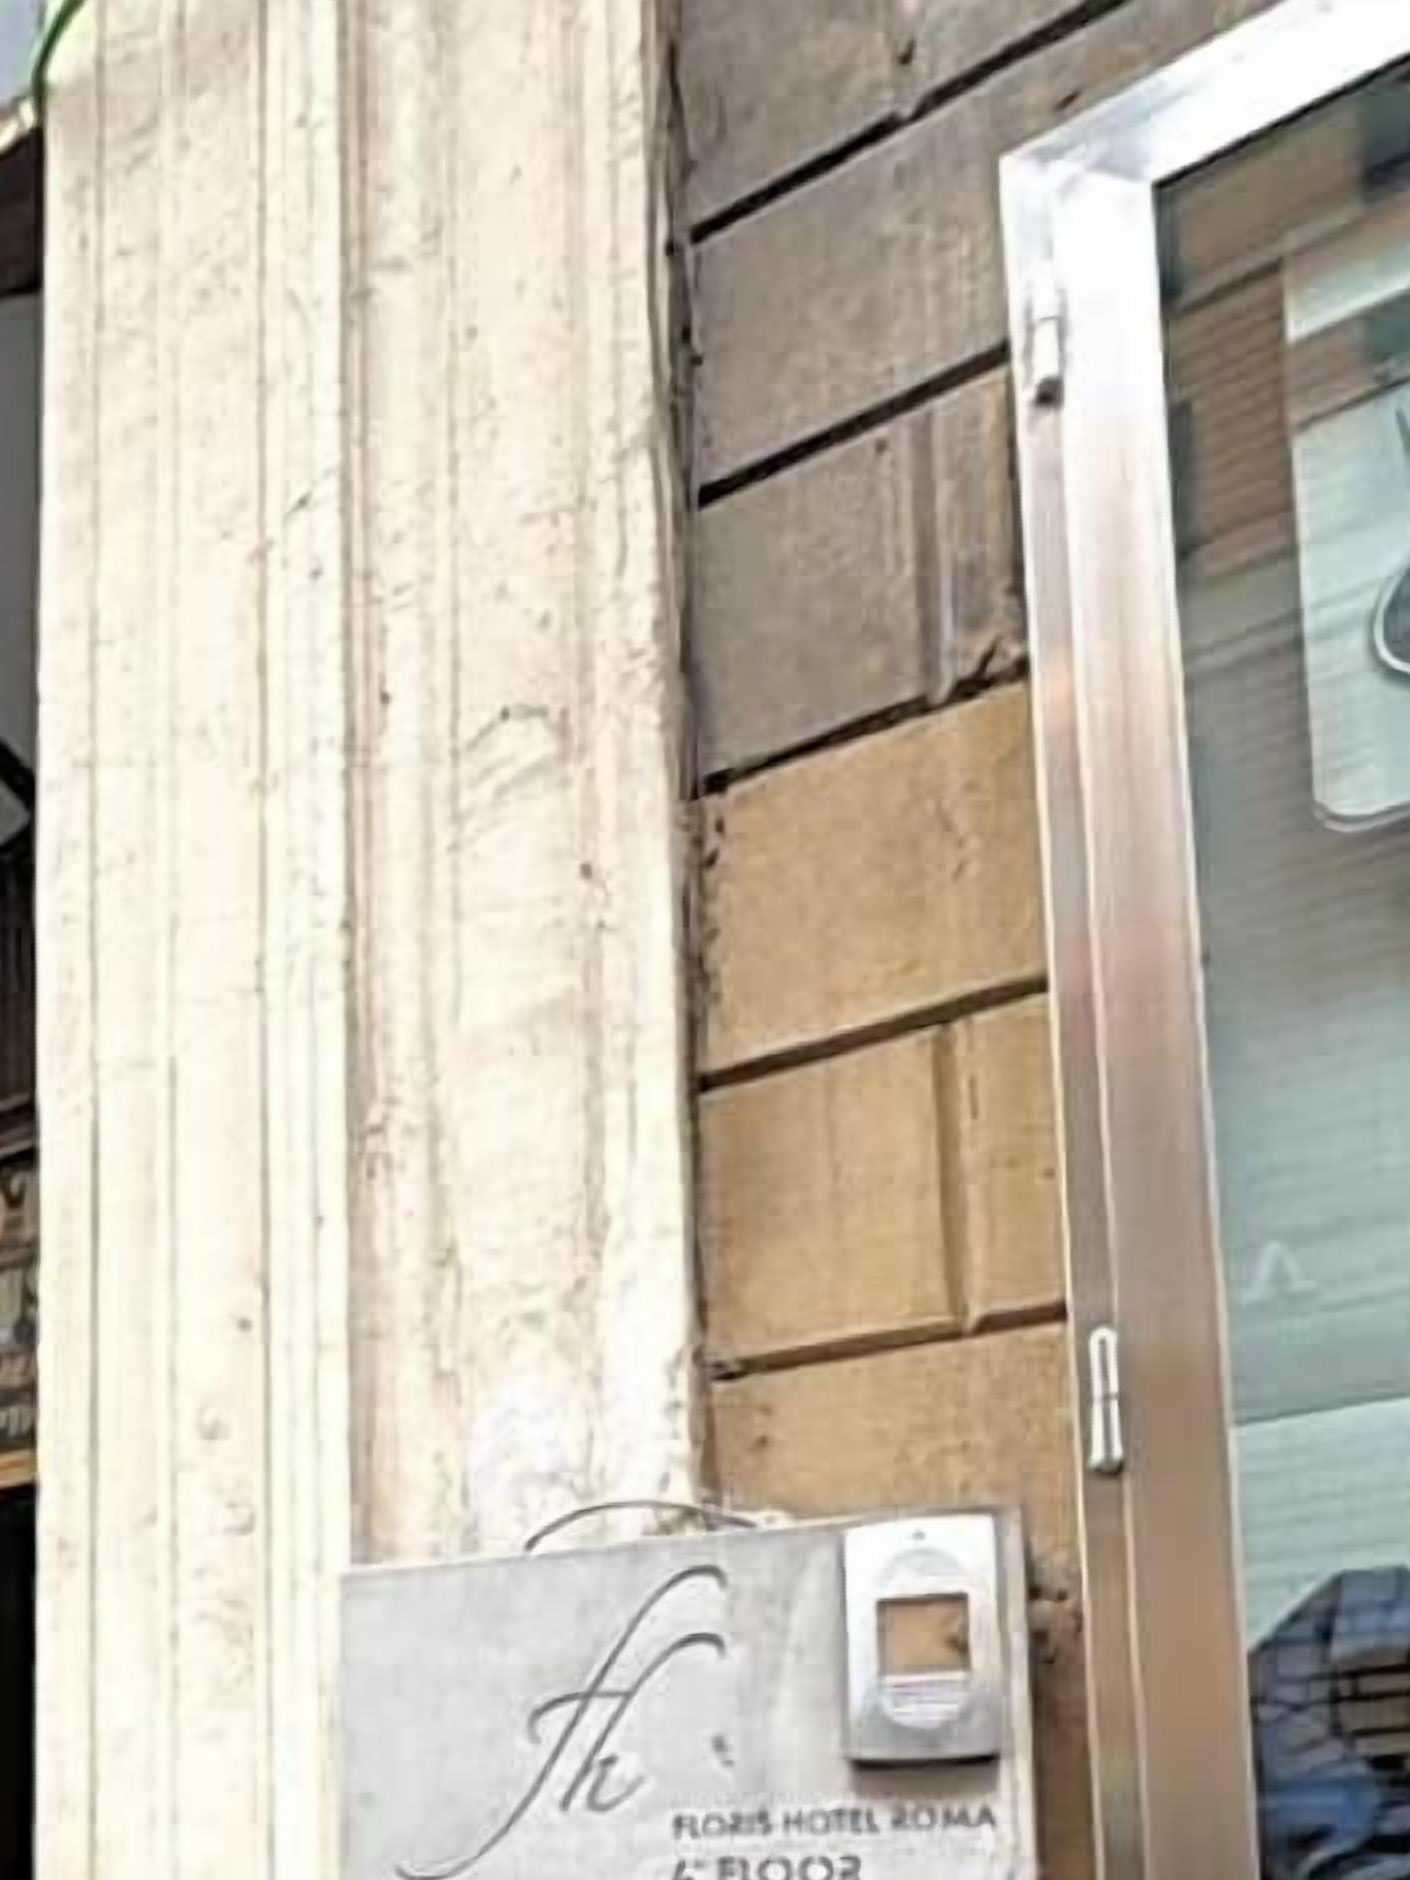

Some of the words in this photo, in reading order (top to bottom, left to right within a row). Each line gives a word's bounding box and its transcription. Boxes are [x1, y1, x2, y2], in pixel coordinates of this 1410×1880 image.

[672, 1808, 774, 1839] FLORIS
[782, 1807, 880, 1835] HOTEL
[890, 1803, 996, 1829] ROMA
